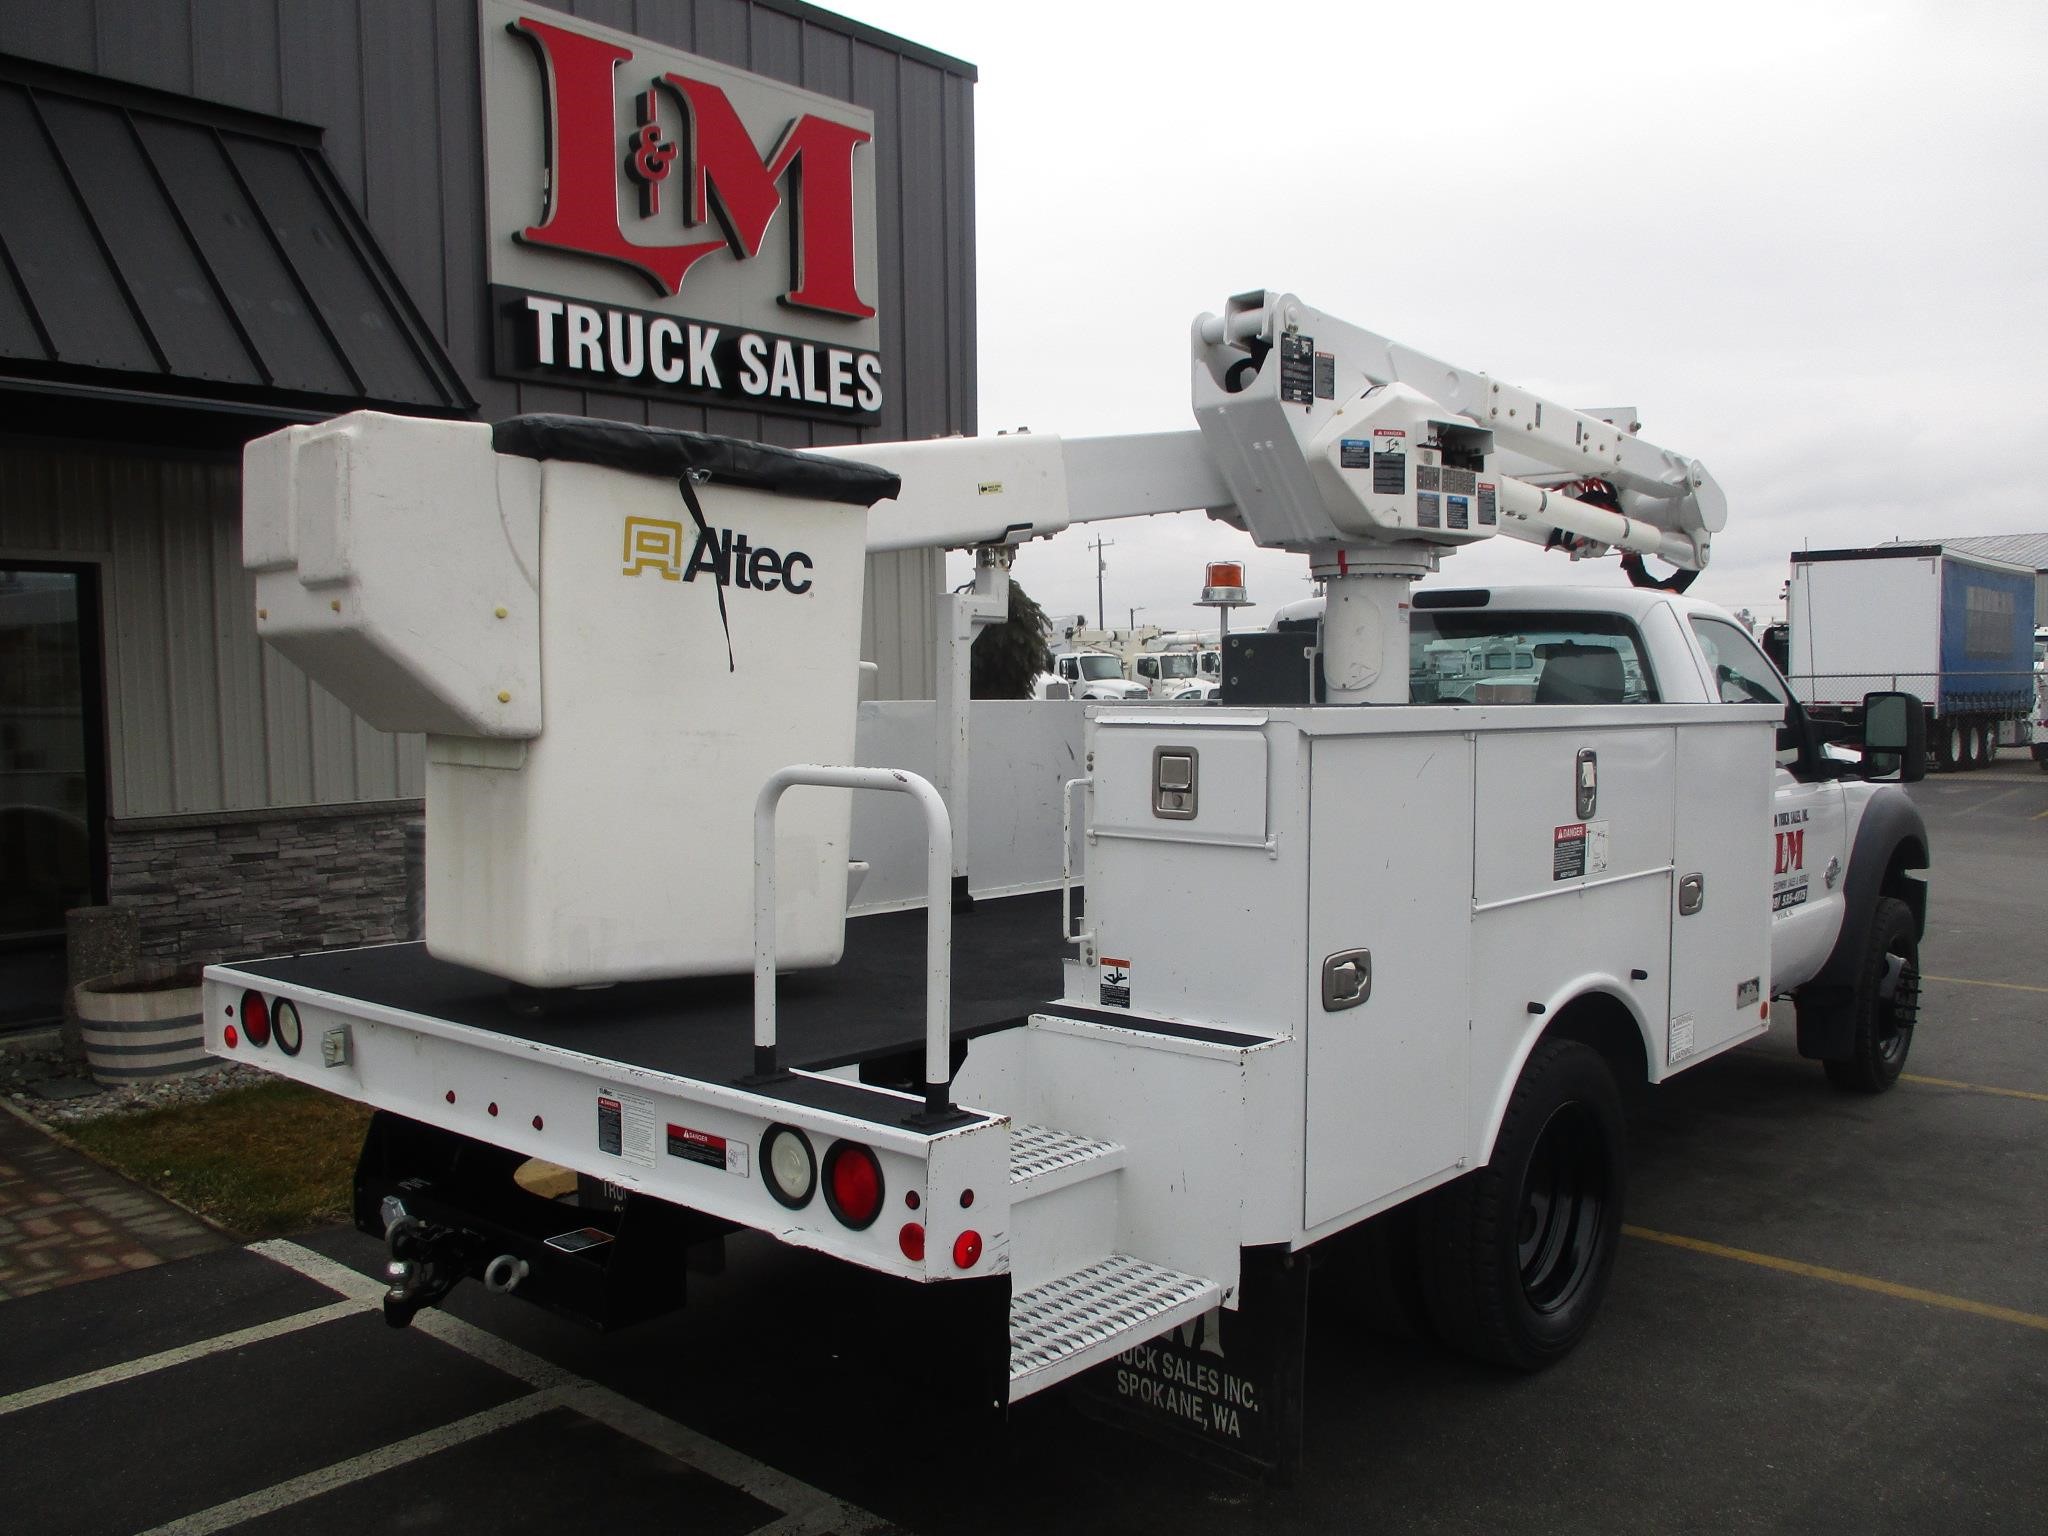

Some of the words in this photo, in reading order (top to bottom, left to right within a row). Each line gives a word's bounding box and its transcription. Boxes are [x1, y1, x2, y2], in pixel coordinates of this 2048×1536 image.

[527, 296, 722, 390] TRUCK
[737, 334, 883, 412] SALES
[683, 527, 813, 595] Altec
[1563, 826, 1583, 838] DANGER
[689, 1131, 708, 1142] DANGER
[1117, 1370, 1208, 1431] SPOKANE,
[1212, 1403, 1241, 1438] WA
[1162, 1353, 1219, 1396] SALES
[1223, 1373, 1259, 1412] INC.
